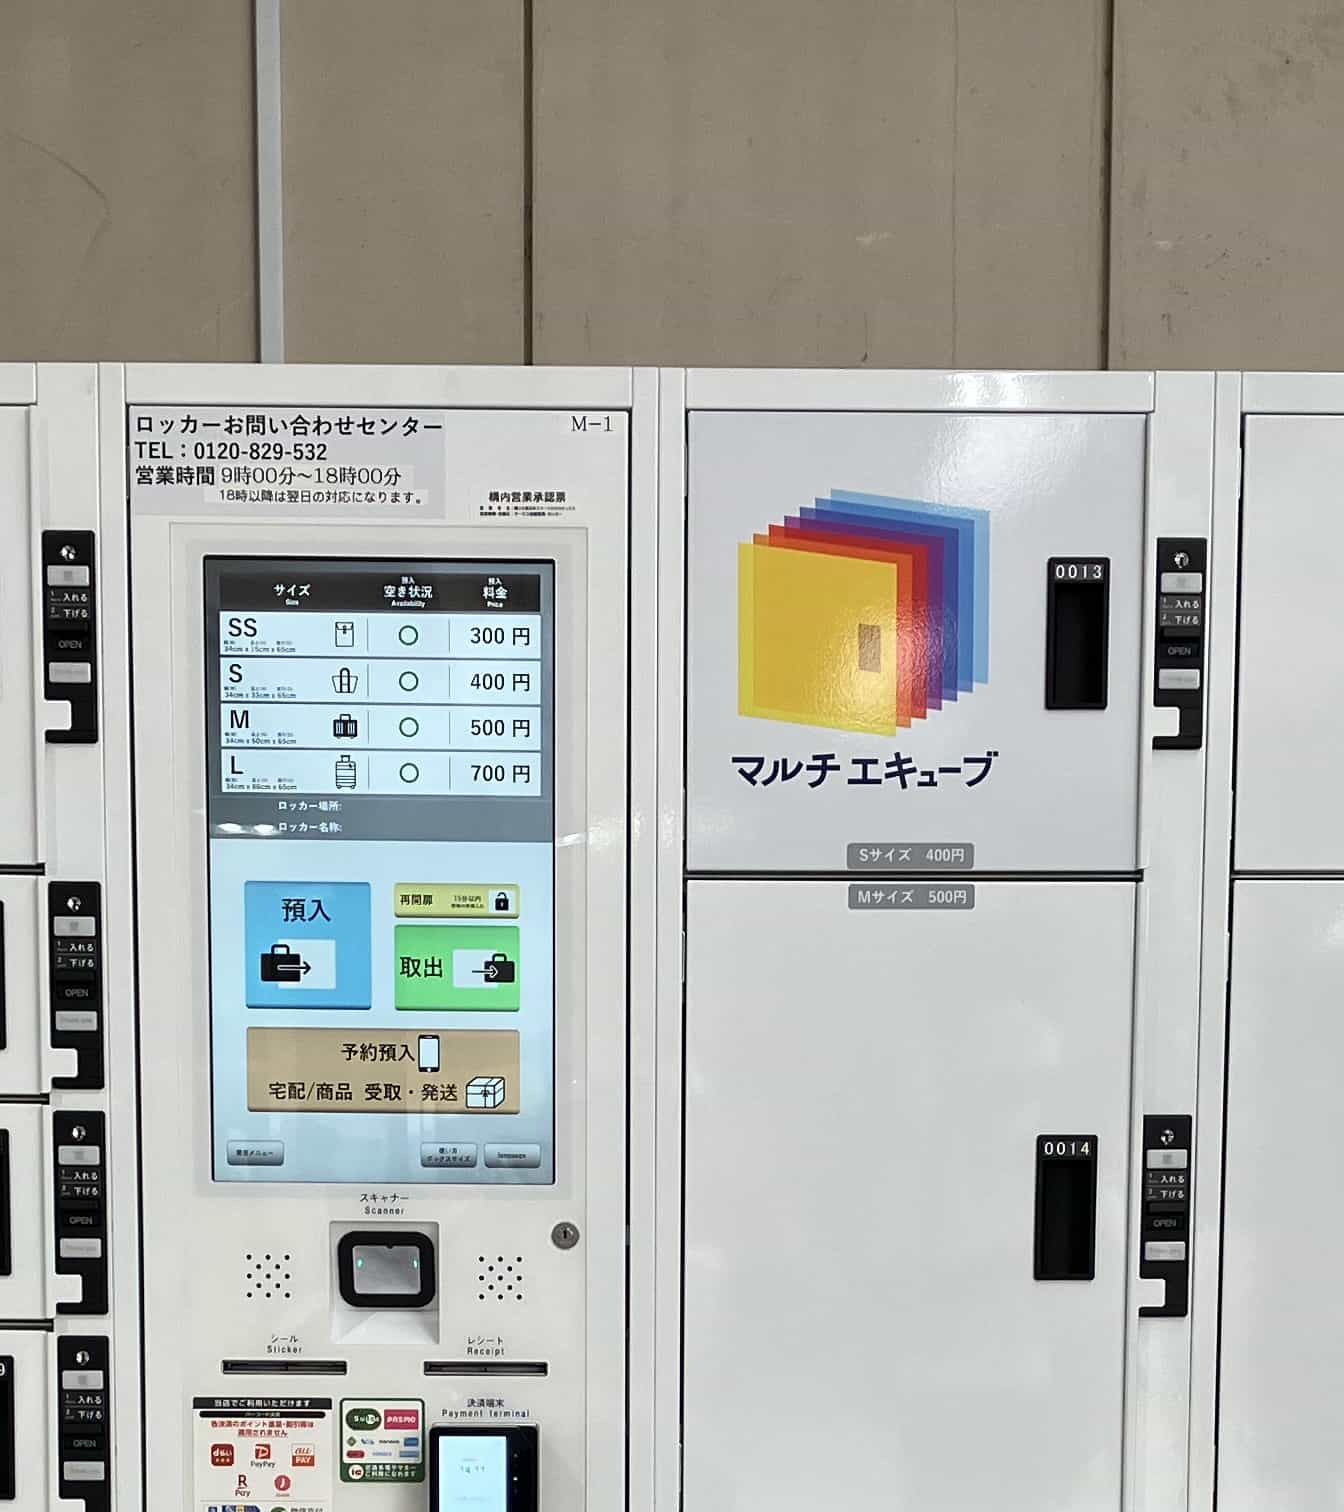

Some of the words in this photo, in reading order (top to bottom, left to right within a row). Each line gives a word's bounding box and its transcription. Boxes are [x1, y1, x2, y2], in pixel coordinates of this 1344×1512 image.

[136, 414, 442, 437] ロッカーお問い合わせセンター
[135, 466, 215, 486] 営業時間
[1056, 565, 1102, 578] 0013
[273, 584, 311, 596] サイズ
[384, 586, 432, 598] 空き状況
[483, 587, 507, 599] 料金
[229, 618, 257, 637] SS
[470, 628, 504, 644] 300
[512, 628, 530, 646] 円
[58, 640, 82, 649] OPEN
[1168, 647, 1191, 655] OPEN
[229, 664, 243, 683] S
[470, 674, 505, 690] 400
[512, 673, 531, 692] 円
[230, 710, 249, 728] M
[471, 719, 505, 736] 500
[512, 719, 531, 738] 円
[231, 756, 243, 774] L
[471, 765, 505, 783] 700
[512, 765, 531, 784] 円
[859, 848, 912, 862] Sサイズ
[926, 849, 964, 862] 400円
[858, 890, 914, 903] Mサイズ
[928, 890, 966, 904] 500円
[281, 898, 331, 923] 預入
[400, 956, 443, 978] 取出
[65, 989, 88, 997] OPEN
[341, 1043, 415, 1062] 予約預入
[269, 1082, 353, 1101] 宅配/商品
[365, 1083, 457, 1102] 受取・発送
[1044, 1142, 1089, 1155] 0014
[359, 1193, 409, 1203] スキャナー
[364, 1206, 405, 1215] Scanner
[271, 1335, 299, 1344] シール
[468, 1336, 504, 1346] レシート
[266, 1345, 303, 1354] Sticker
[467, 1346, 505, 1357] Receipt
[467, 1399, 504, 1408] 決済端末
[442, 1409, 483, 1418] Payment
[295, 1456, 311, 1464] PAY
